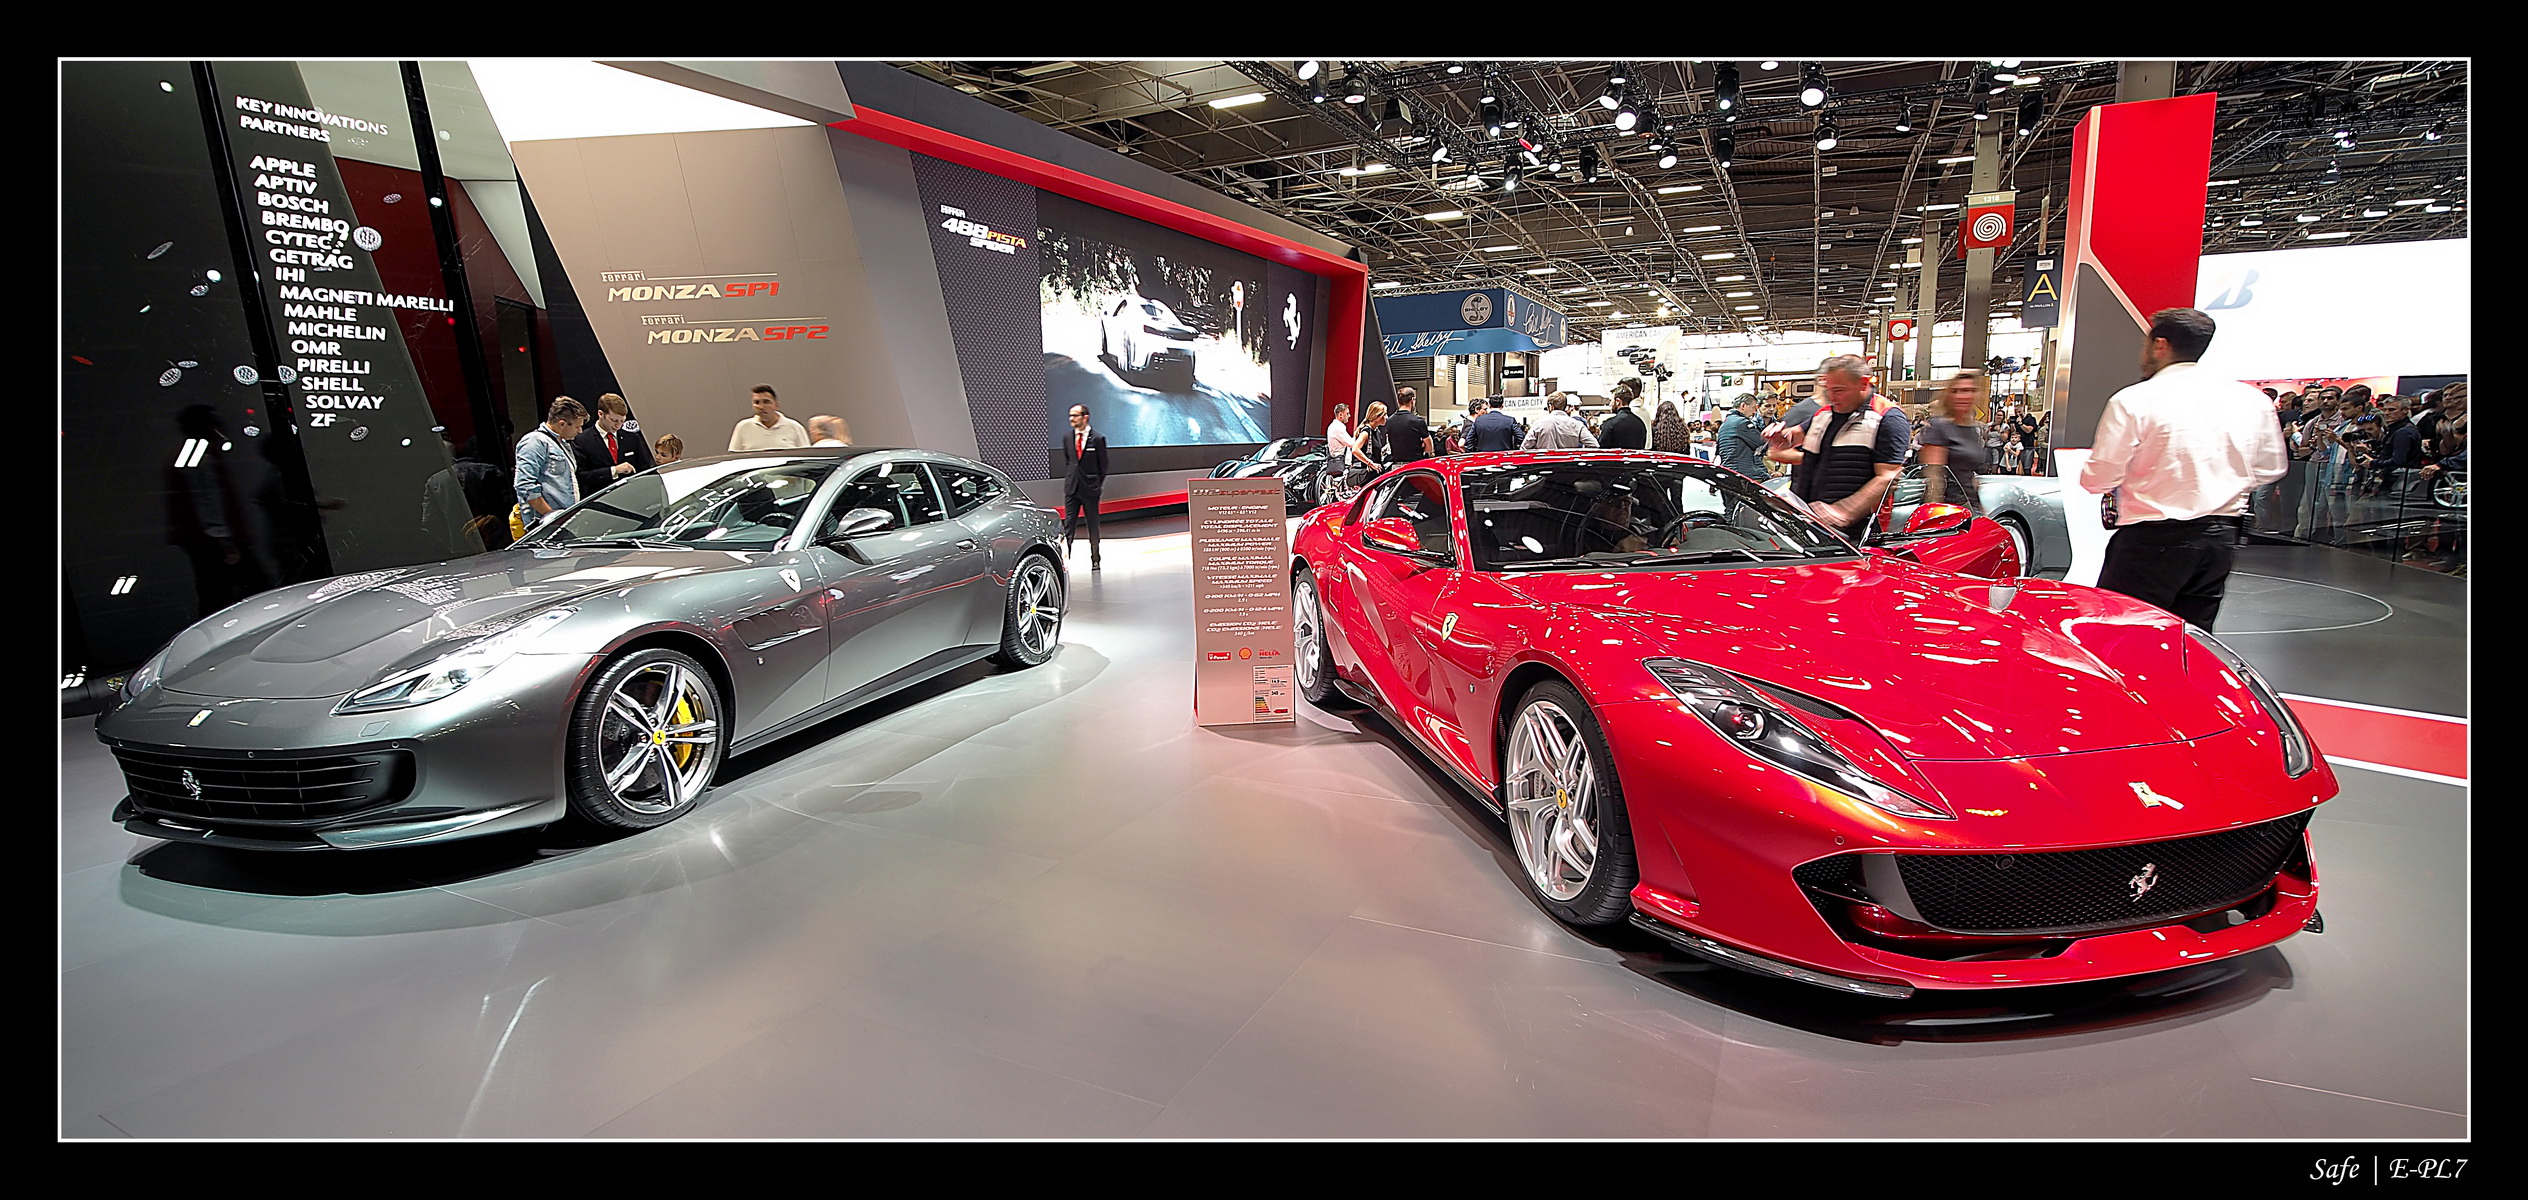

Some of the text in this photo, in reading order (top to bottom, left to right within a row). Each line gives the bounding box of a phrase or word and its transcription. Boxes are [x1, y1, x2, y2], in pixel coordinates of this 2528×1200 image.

[236, 96, 388, 136] KEY INNOVATIONS
[240, 115, 331, 143] PARTNERS
[249, 154, 316, 178] APPLE
[254, 174, 318, 195] APTIV
[257, 191, 329, 214] BOSCH
[261, 210, 349, 234] BREMBO
[941, 217, 1028, 249] 488 PISTA
[270, 248, 353, 270] GETRAG
[275, 266, 305, 283] IHI
[601, 270, 646, 283] Ferrari
[607, 281, 780, 303] MONZA SP1
[2027, 273, 2058, 302] A
[280, 285, 454, 312] MAGNETI MARELLI
[284, 304, 357, 322] MAHLE
[641, 314, 686, 326] Ferrari
[288, 321, 386, 341] MICHELIN
[647, 325, 830, 345] MONZA SP2
[291, 339, 341, 356] OMR
[297, 357, 370, 375] PIRELLI
[301, 376, 364, 392] SHELL
[305, 394, 384, 411] SOLVAY
[310, 413, 337, 428] ZF
